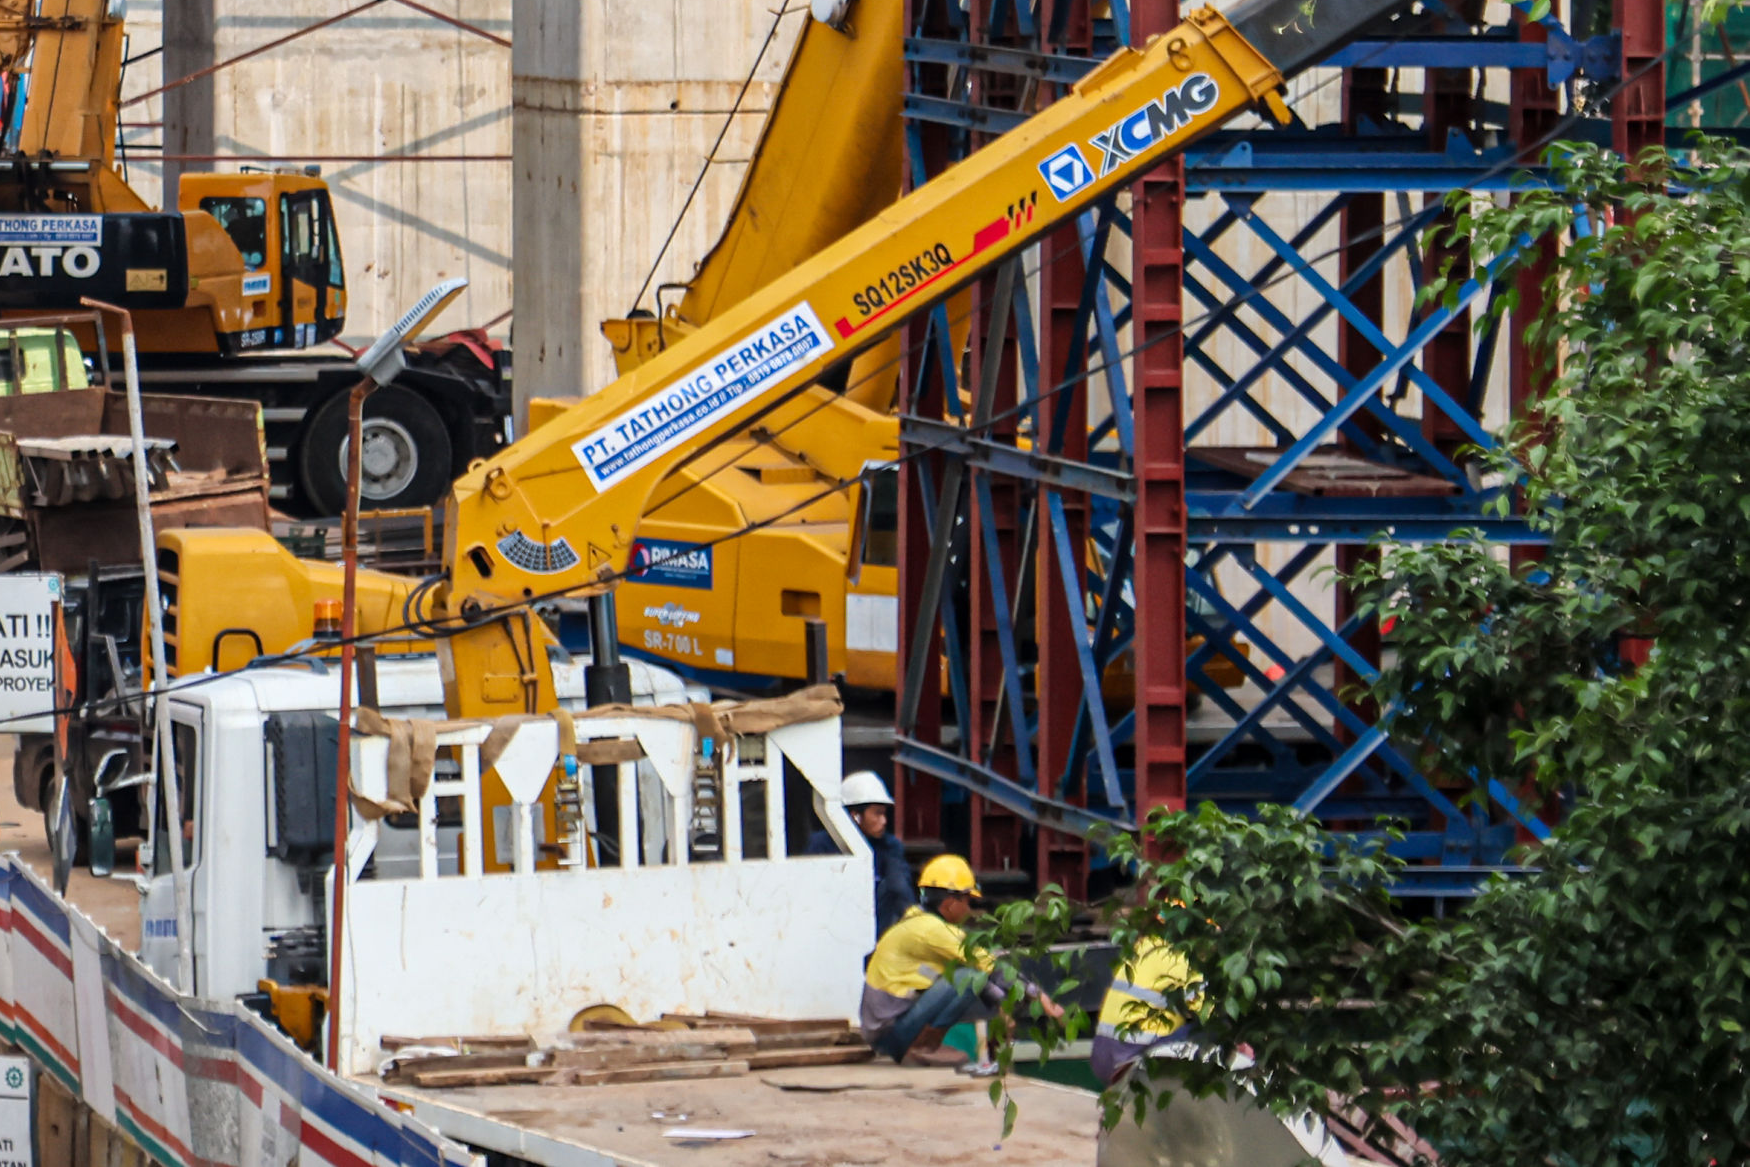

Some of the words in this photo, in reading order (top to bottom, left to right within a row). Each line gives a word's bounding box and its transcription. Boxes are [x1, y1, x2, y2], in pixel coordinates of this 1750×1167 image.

[1087, 71, 1219, 179] XCMG
[41, 219, 98, 231] PERKASA
[853, 242, 955, 316] SQ12SK3Q
[582, 435, 616, 465] PT.
[615, 373, 715, 444] TATHONG
[713, 314, 812, 382] PERKASA
